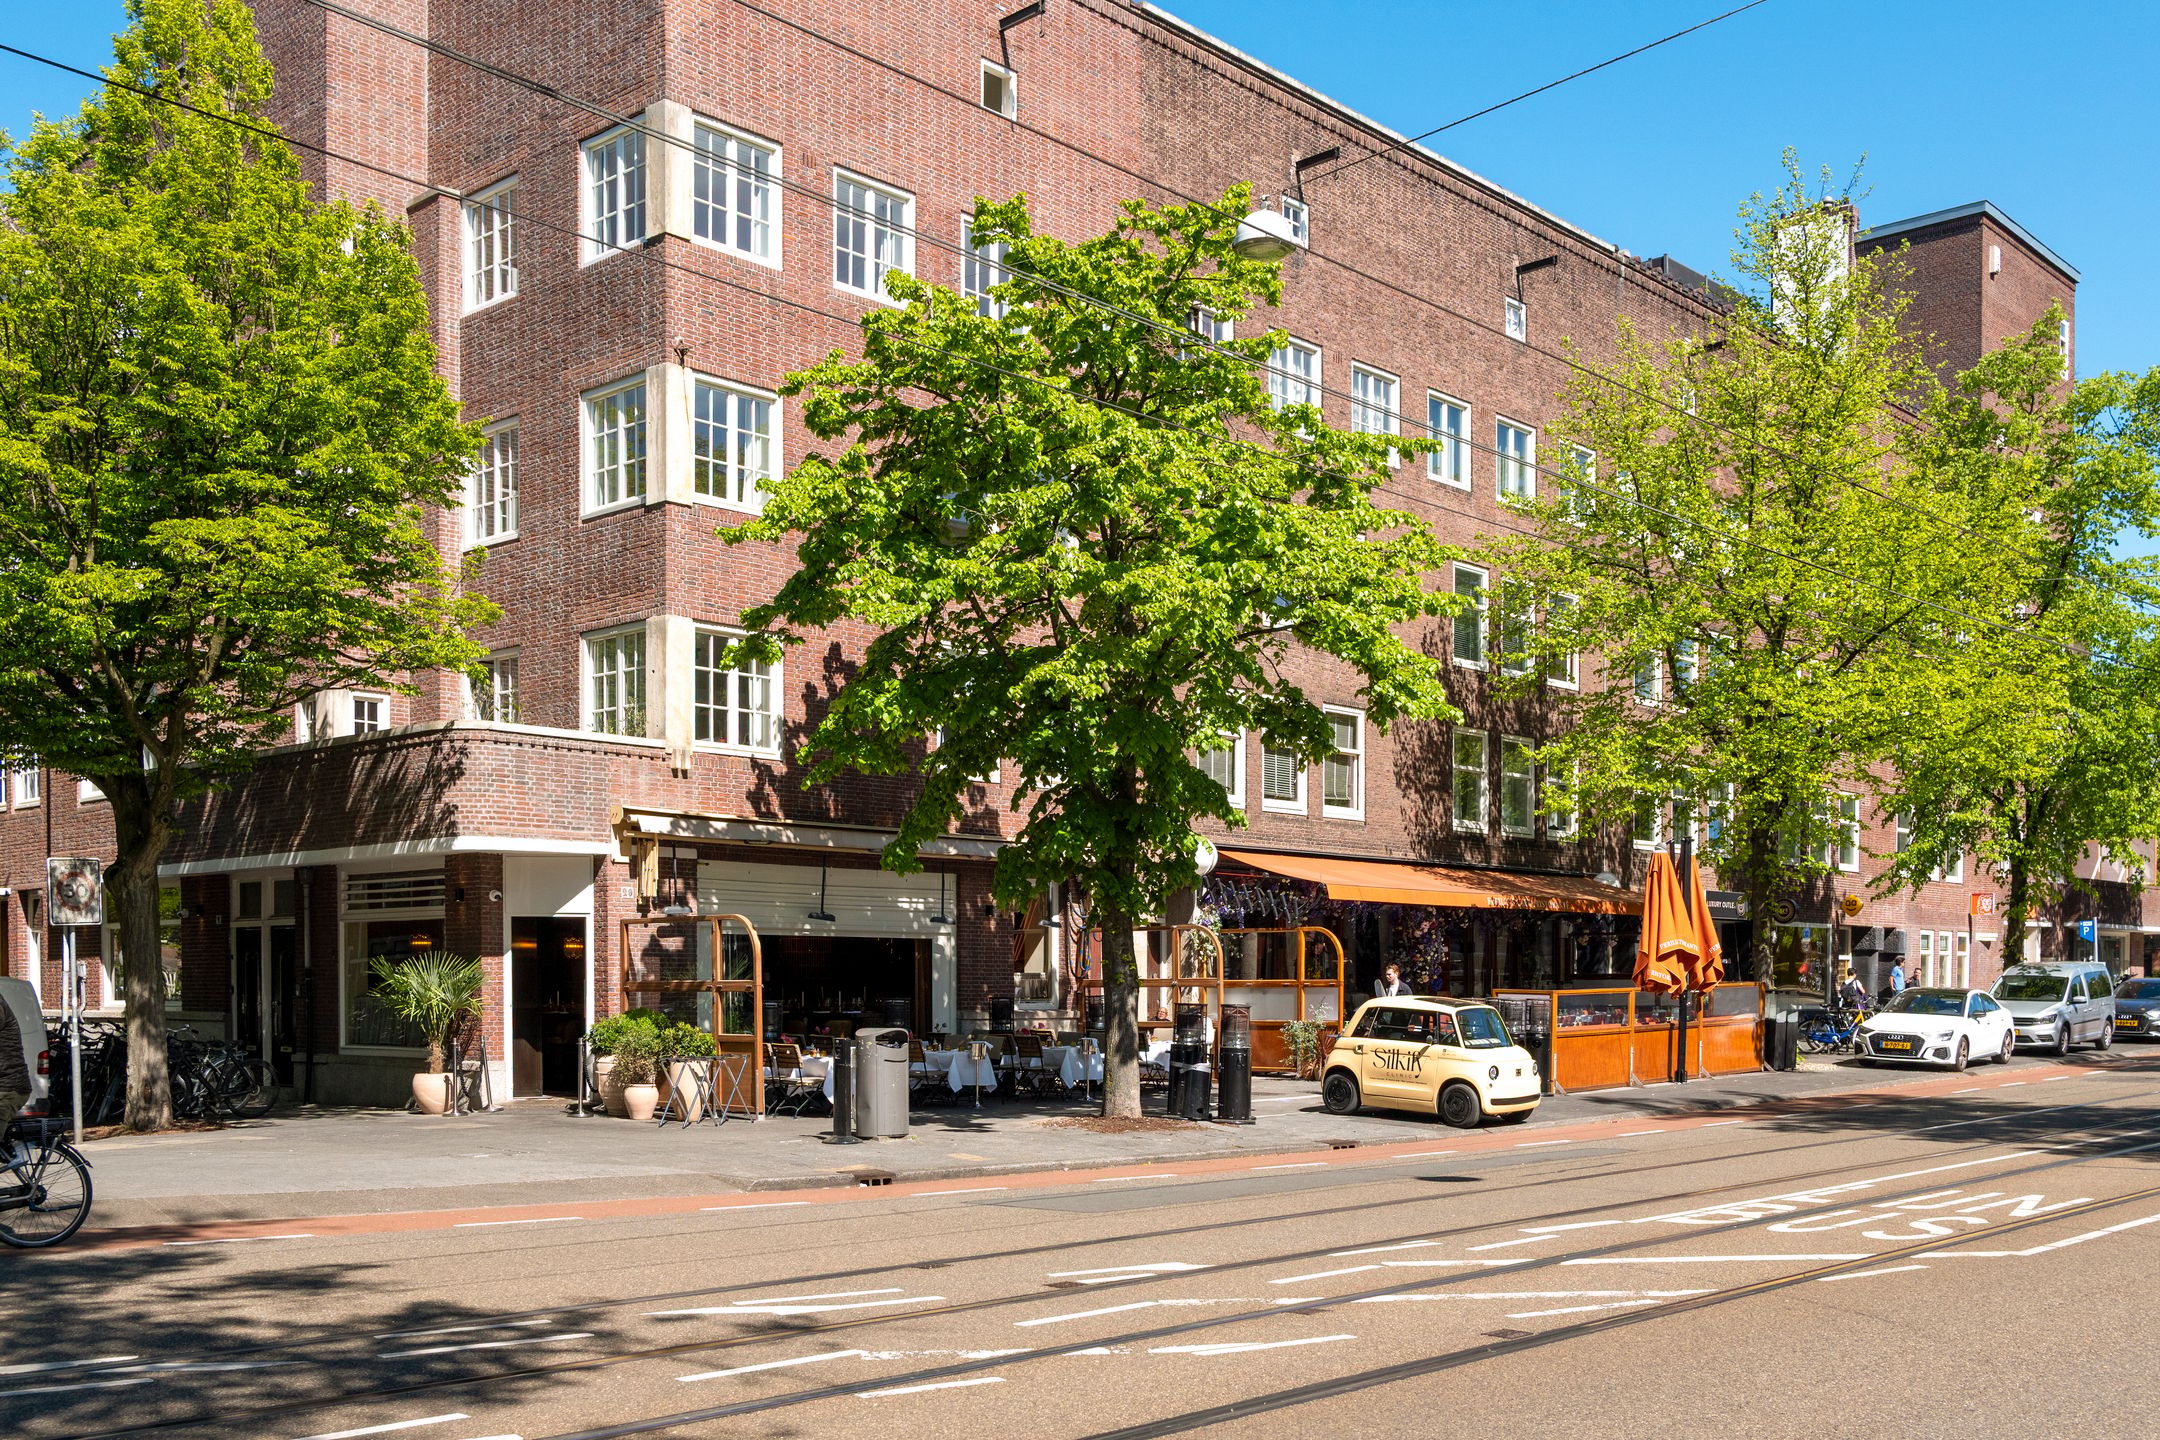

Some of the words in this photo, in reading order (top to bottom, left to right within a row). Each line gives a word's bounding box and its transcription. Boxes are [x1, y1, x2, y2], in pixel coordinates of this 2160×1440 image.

[64, 884, 88, 898] 30
[2083, 926, 2090, 936] P
[1372, 1047, 1422, 1079] Silkify
[1386, 1071, 1413, 1079] CLINIC
